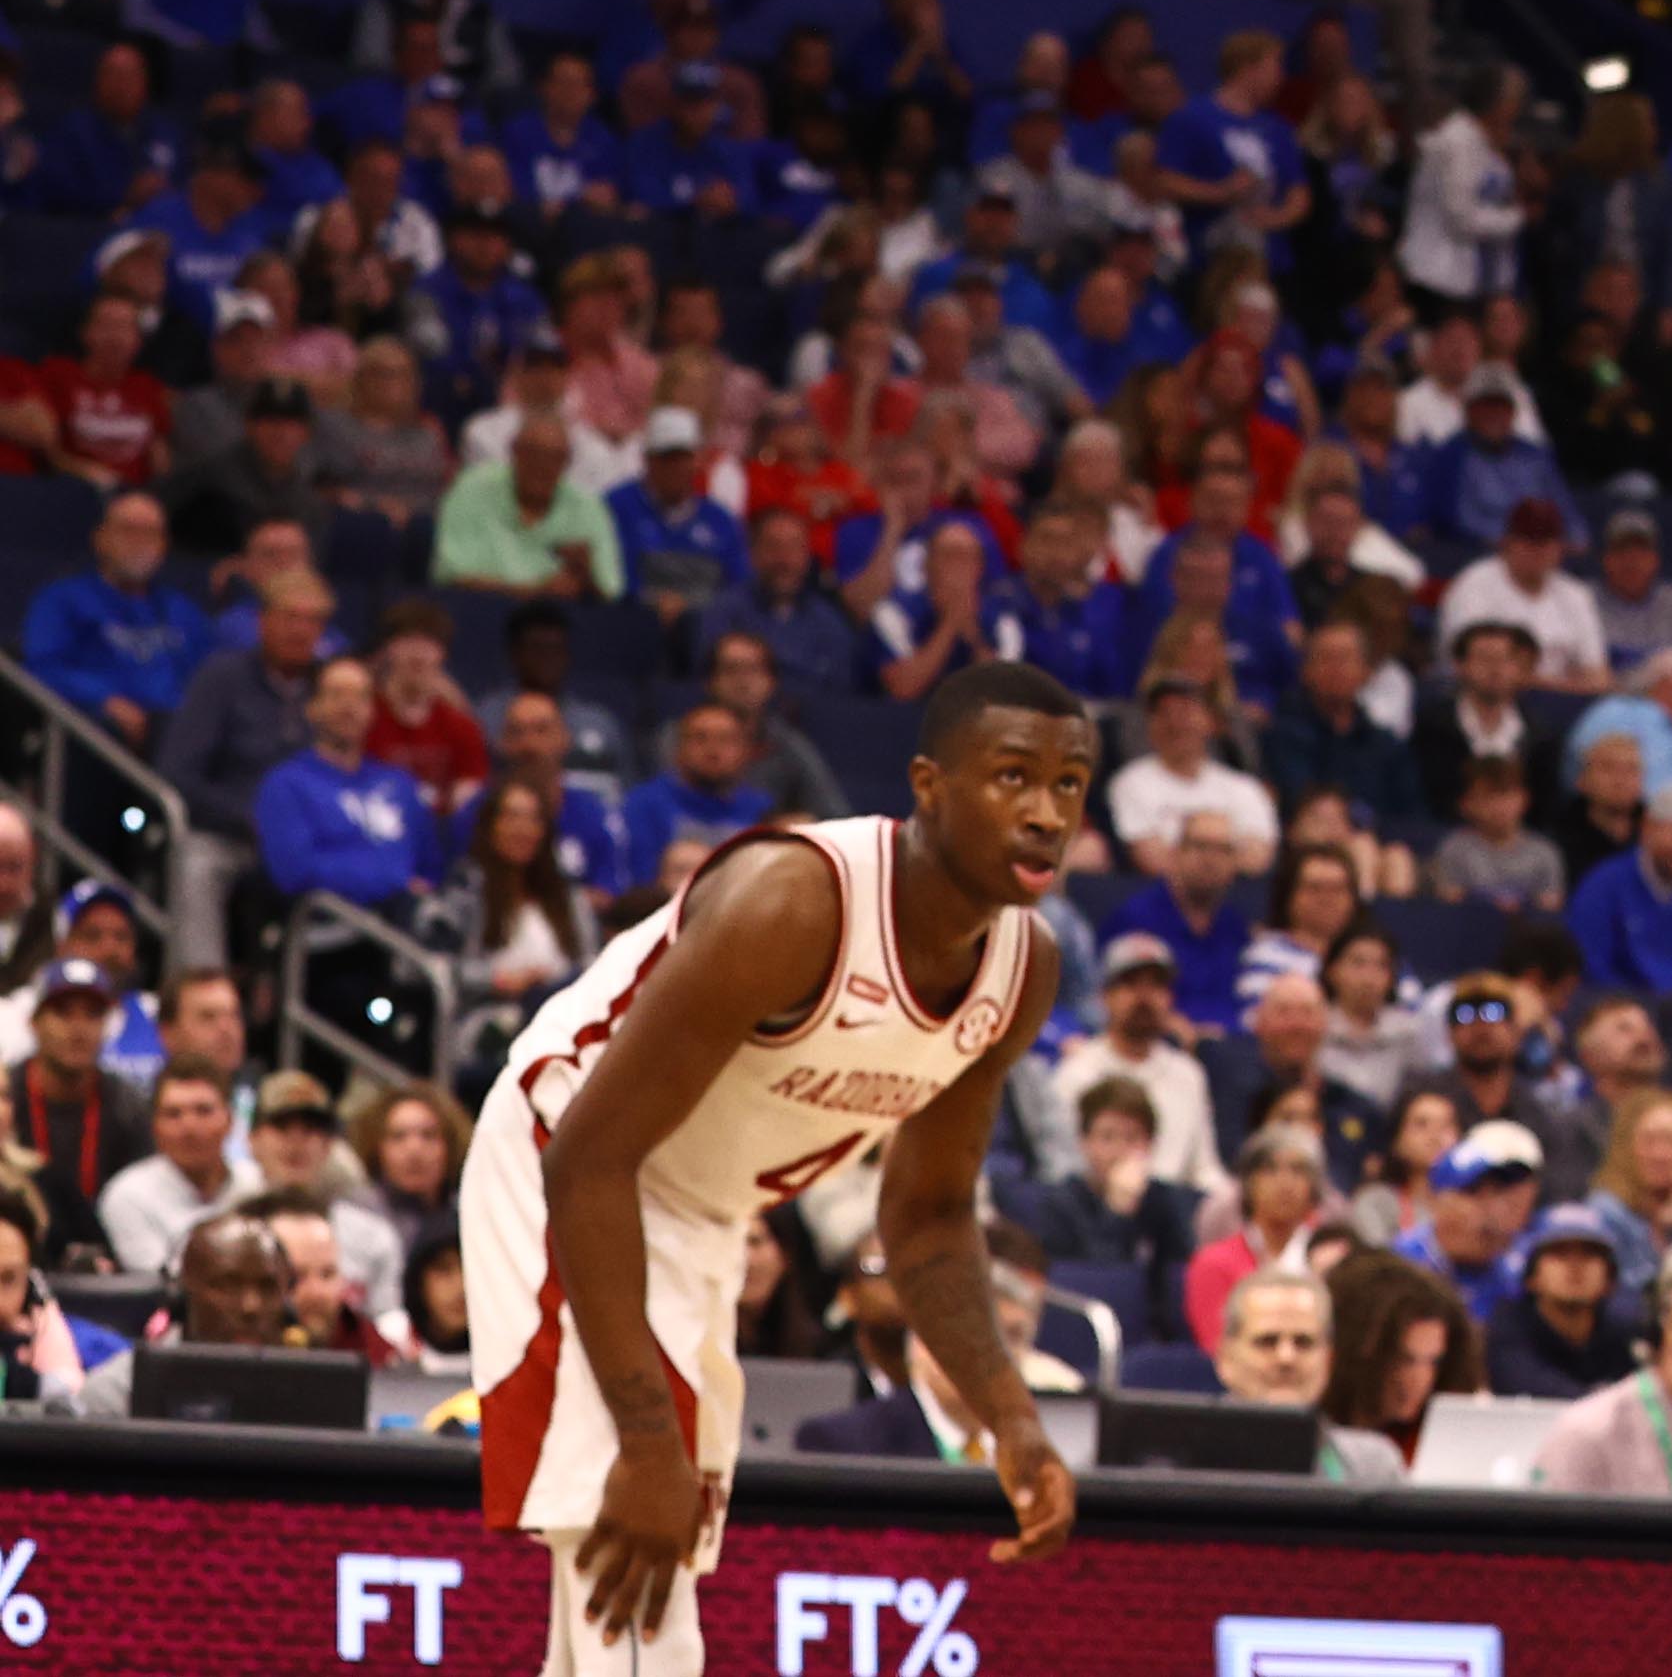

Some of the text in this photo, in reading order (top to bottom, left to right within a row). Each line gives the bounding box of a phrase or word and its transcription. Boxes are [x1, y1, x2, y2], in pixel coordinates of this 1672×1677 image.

[756, 1130, 866, 1216] 4
[335, 1554, 463, 1664] FT
[776, 1573, 979, 1677] FT%
